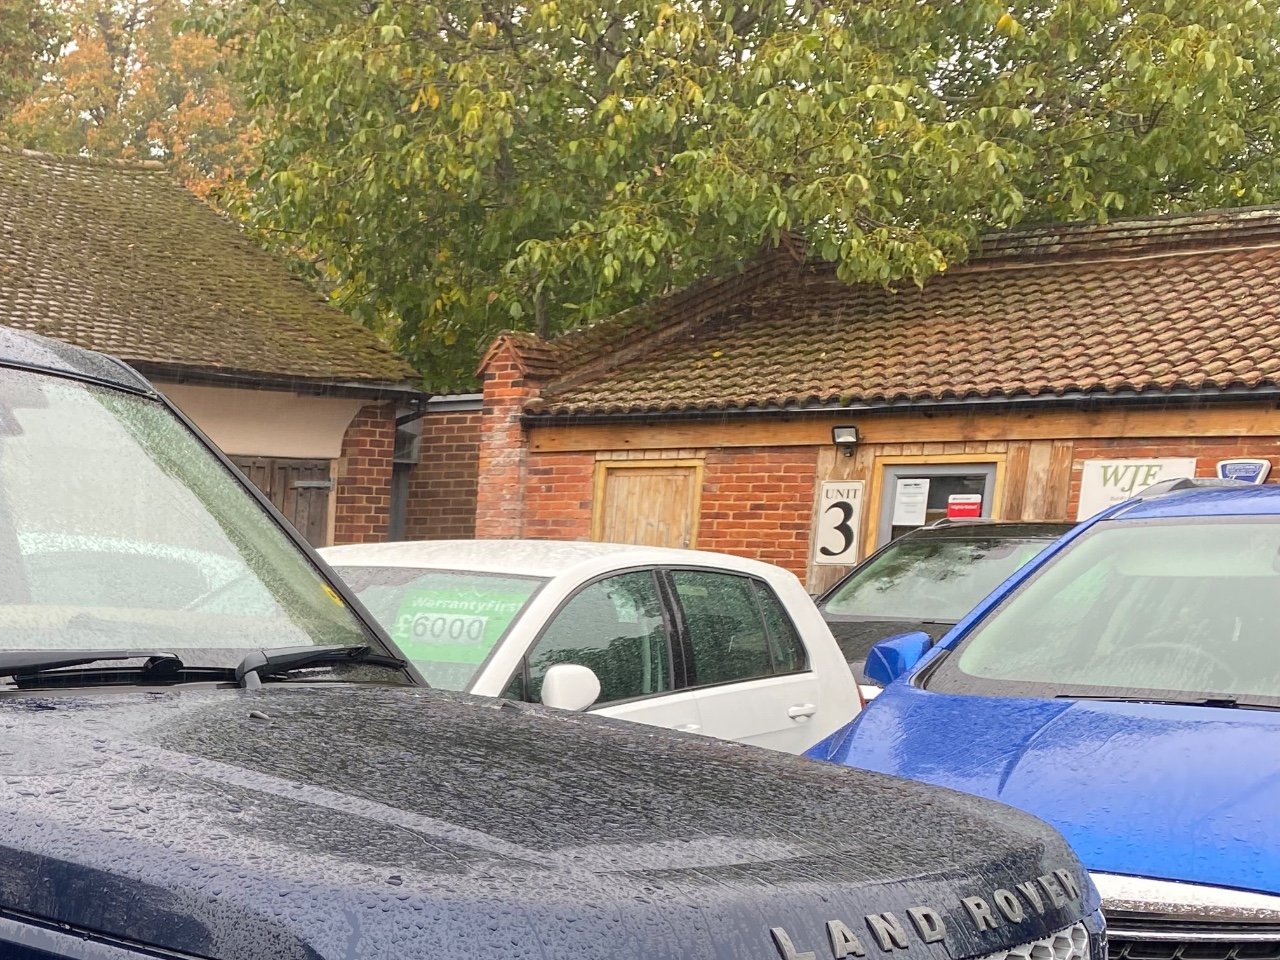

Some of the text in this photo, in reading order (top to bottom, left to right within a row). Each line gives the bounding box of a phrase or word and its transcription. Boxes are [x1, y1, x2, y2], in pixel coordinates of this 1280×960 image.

[1101, 464, 1163, 492] WJF
[825, 488, 861, 500] UNIT
[819, 500, 855, 557] 3
[392, 613, 485, 641] £6000
[961, 867, 1081, 932] ROVER
